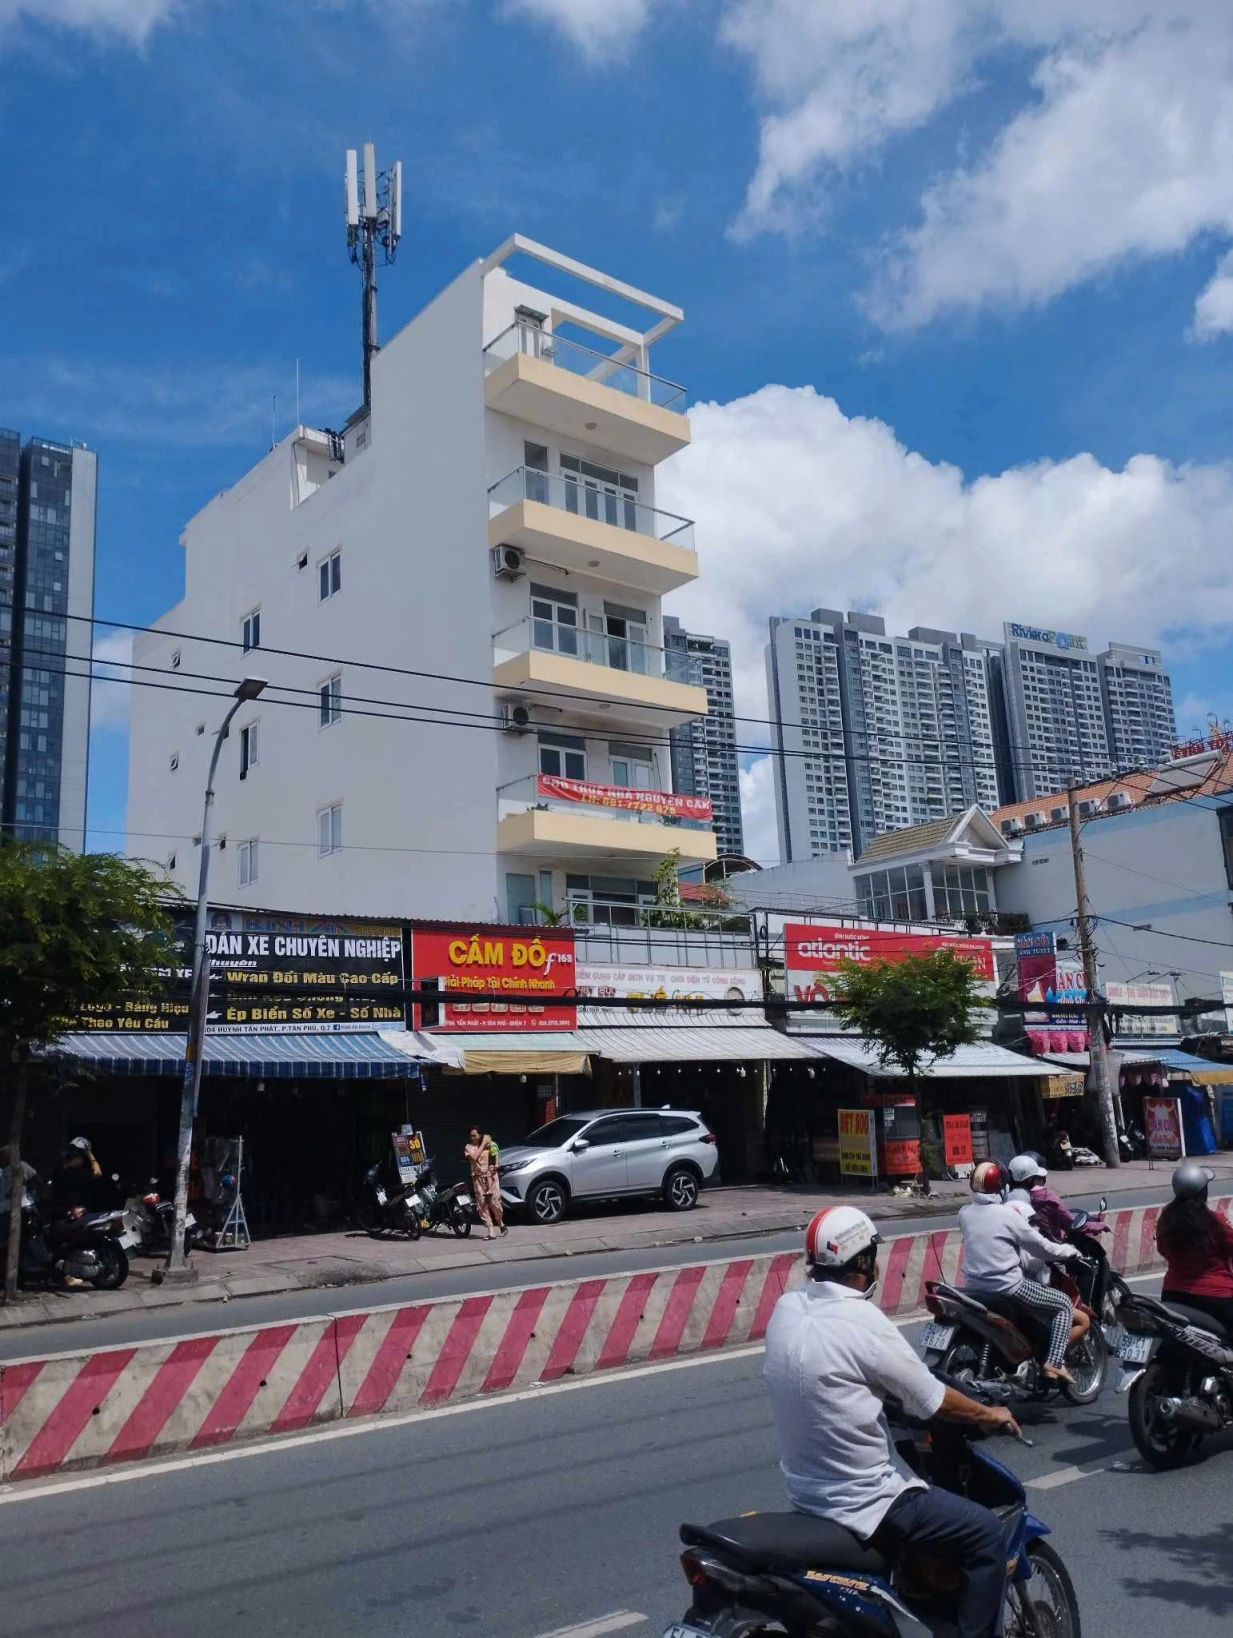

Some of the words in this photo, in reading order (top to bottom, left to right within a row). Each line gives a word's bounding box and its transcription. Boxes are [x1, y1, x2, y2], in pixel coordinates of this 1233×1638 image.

[1011, 623, 1049, 642] Riviera
[607, 787, 632, 799] NHÀ
[205, 932, 242, 955] DÁN
[247, 936, 269, 955] XE
[274, 935, 340, 957] CHUYÊN
[344, 936, 401, 962] NGHIỆP
[448, 934, 503, 965] CẦM
[511, 935, 546, 967] ĐỒ
[798, 938, 871, 961] atlantic
[272, 970, 298, 984] Đổi
[303, 972, 336, 984] Màu
[340, 972, 367, 984] Cao
[371, 971, 398, 985] Cấp
[226, 1007, 247, 1021] Ép
[251, 1006, 287, 1020] Biển
[292, 1005, 312, 1019] Số
[316, 1008, 335, 1019] Xe
[350, 1005, 369, 1019] Số
[373, 1007, 401, 1018] Nhà
[117, 1017, 141, 1028] Yêu
